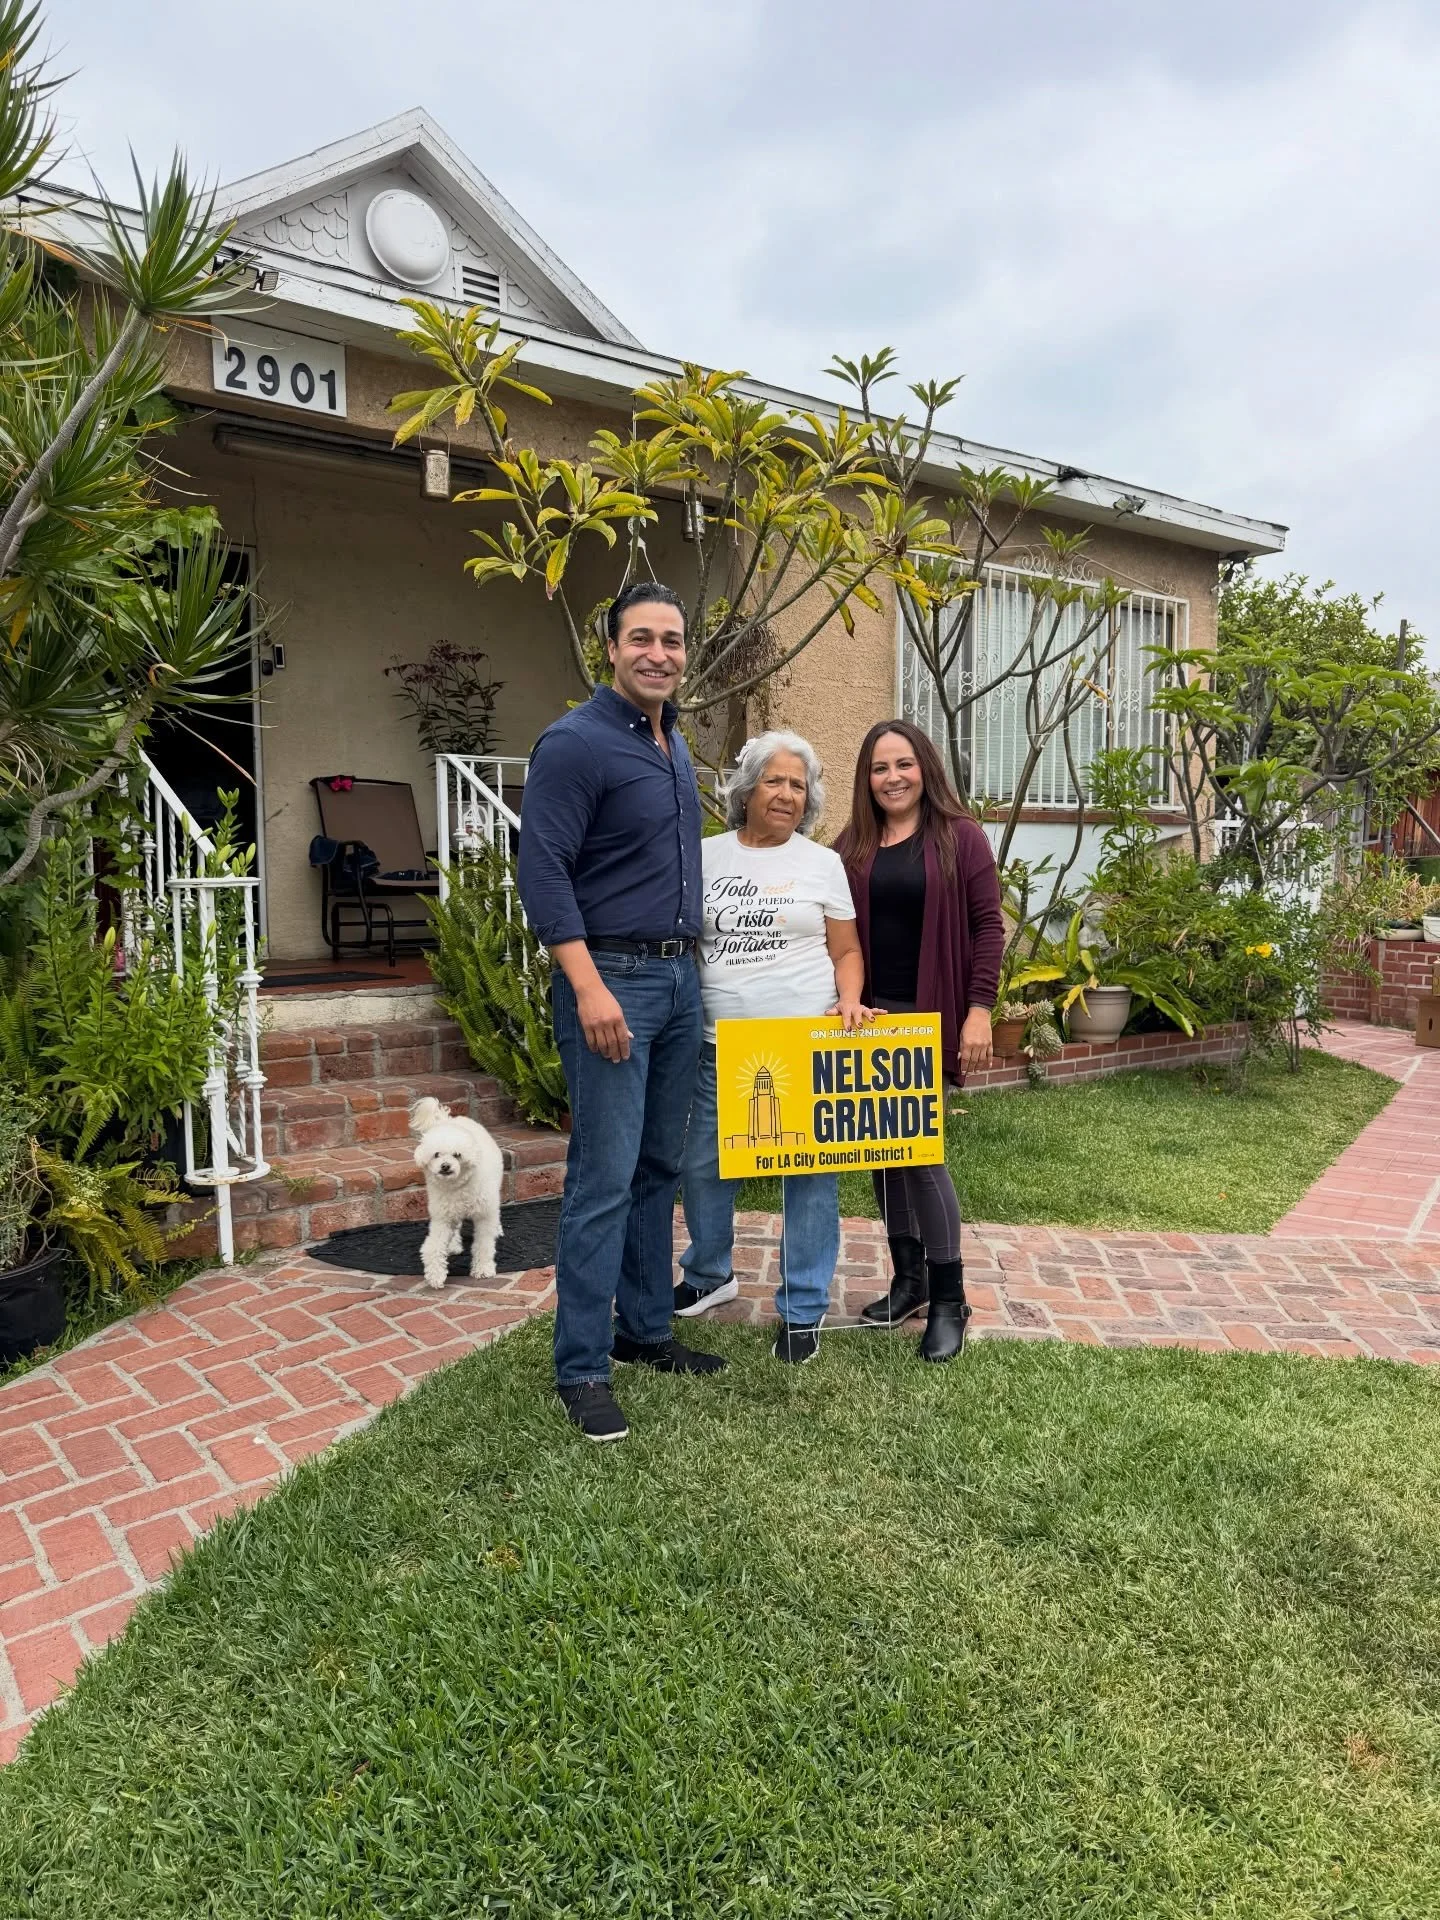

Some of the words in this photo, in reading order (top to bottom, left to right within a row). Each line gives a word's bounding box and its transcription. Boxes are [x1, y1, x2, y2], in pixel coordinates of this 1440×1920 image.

[224, 346, 337, 410] 2901
[704, 876, 758, 903] Todo
[740, 898, 754, 906] LO
[758, 897, 795, 906] PUEDO
[706, 906, 719, 915] EN
[715, 905, 779, 934] Cristo
[766, 930, 782, 938] ME
[707, 934, 789, 964] Fortalece
[810, 1029, 827, 1039] ON
[829, 1028, 857, 1039] JUNE
[859, 1028, 881, 1038] 2ND
[881, 1026, 911, 1037] VOTE
[911, 1026, 934, 1036] FOR
[812, 1046, 934, 1095] NELSON
[813, 1094, 939, 1144] GRANDE
[755, 1155, 775, 1170] For
[777, 1153, 791, 1169] LA
[793, 1151, 815, 1168] City
[818, 1149, 861, 1166] Council
[864, 1146, 905, 1163] District
[907, 1145, 913, 1160] 1
